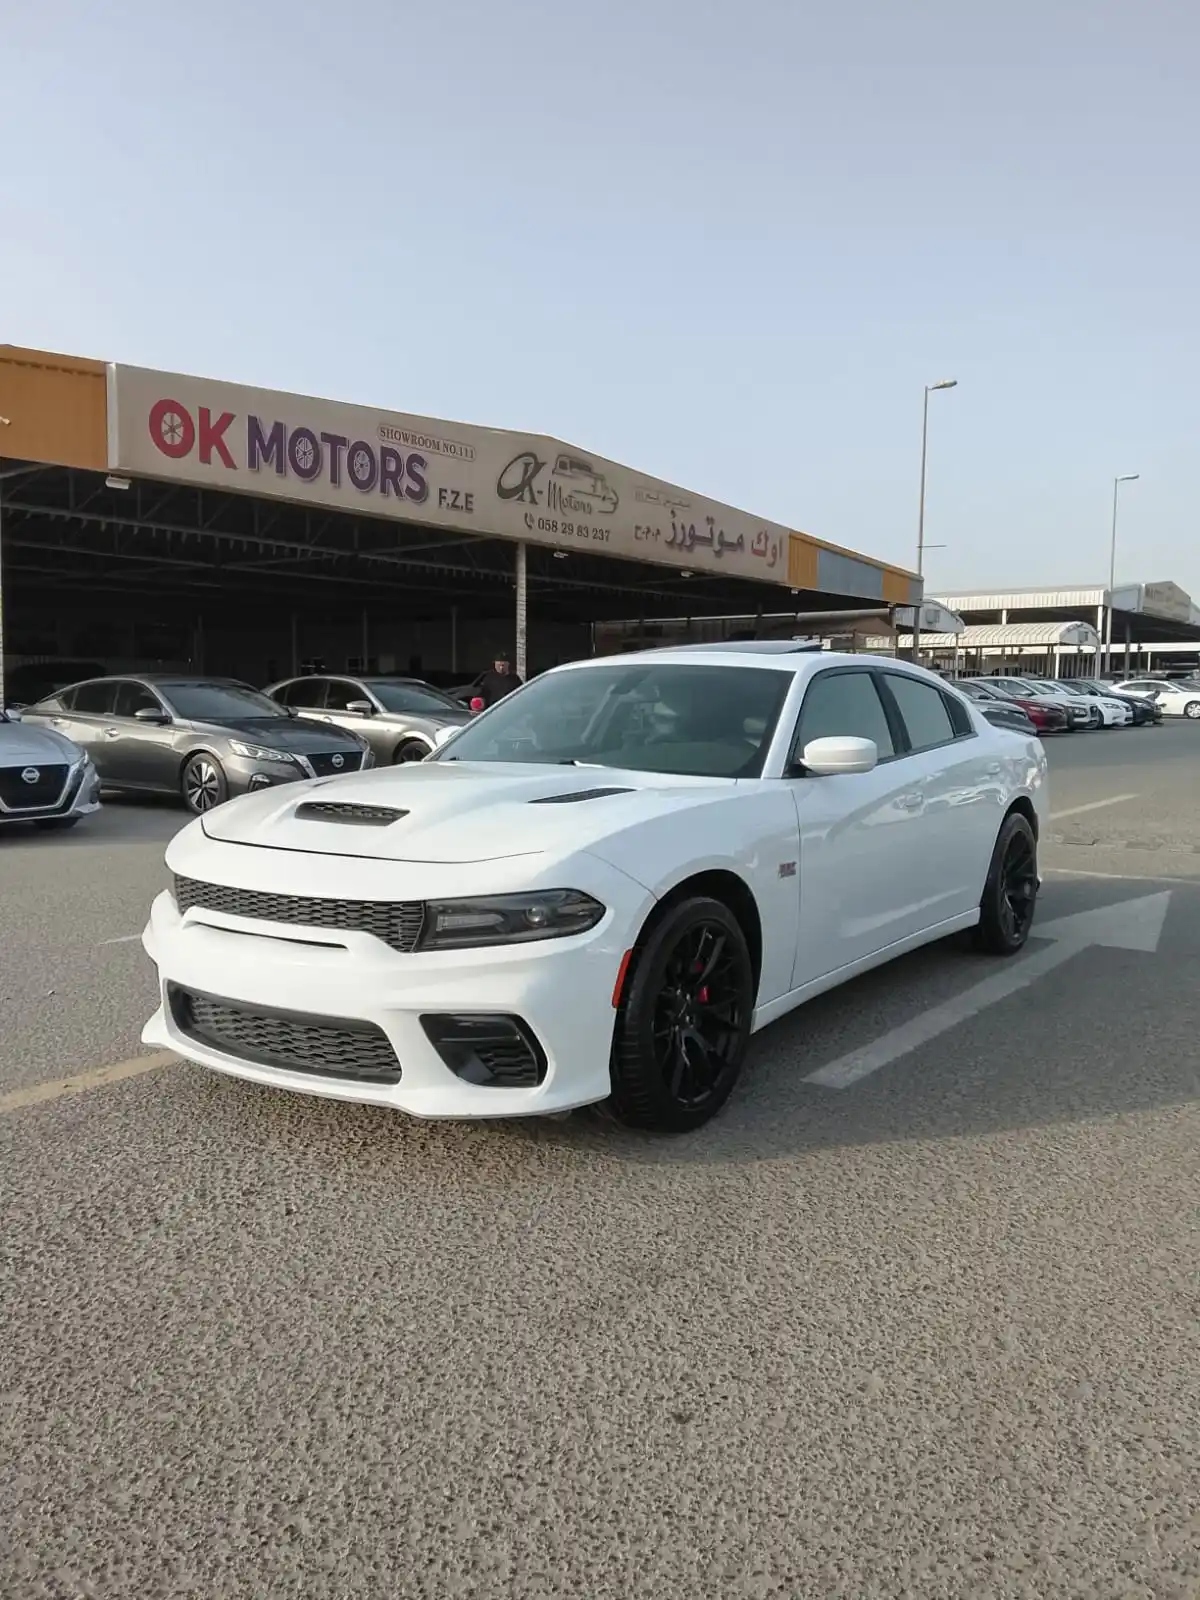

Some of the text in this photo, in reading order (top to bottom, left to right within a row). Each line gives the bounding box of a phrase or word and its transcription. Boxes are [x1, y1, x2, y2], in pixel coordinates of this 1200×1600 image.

[149, 399, 474, 513] OK MOTORS F.Z.E
[380, 427, 440, 451] SHOWROOM
[538, 518, 611, 542] 058 29 83 237
[664, 508, 744, 559] موتورز
